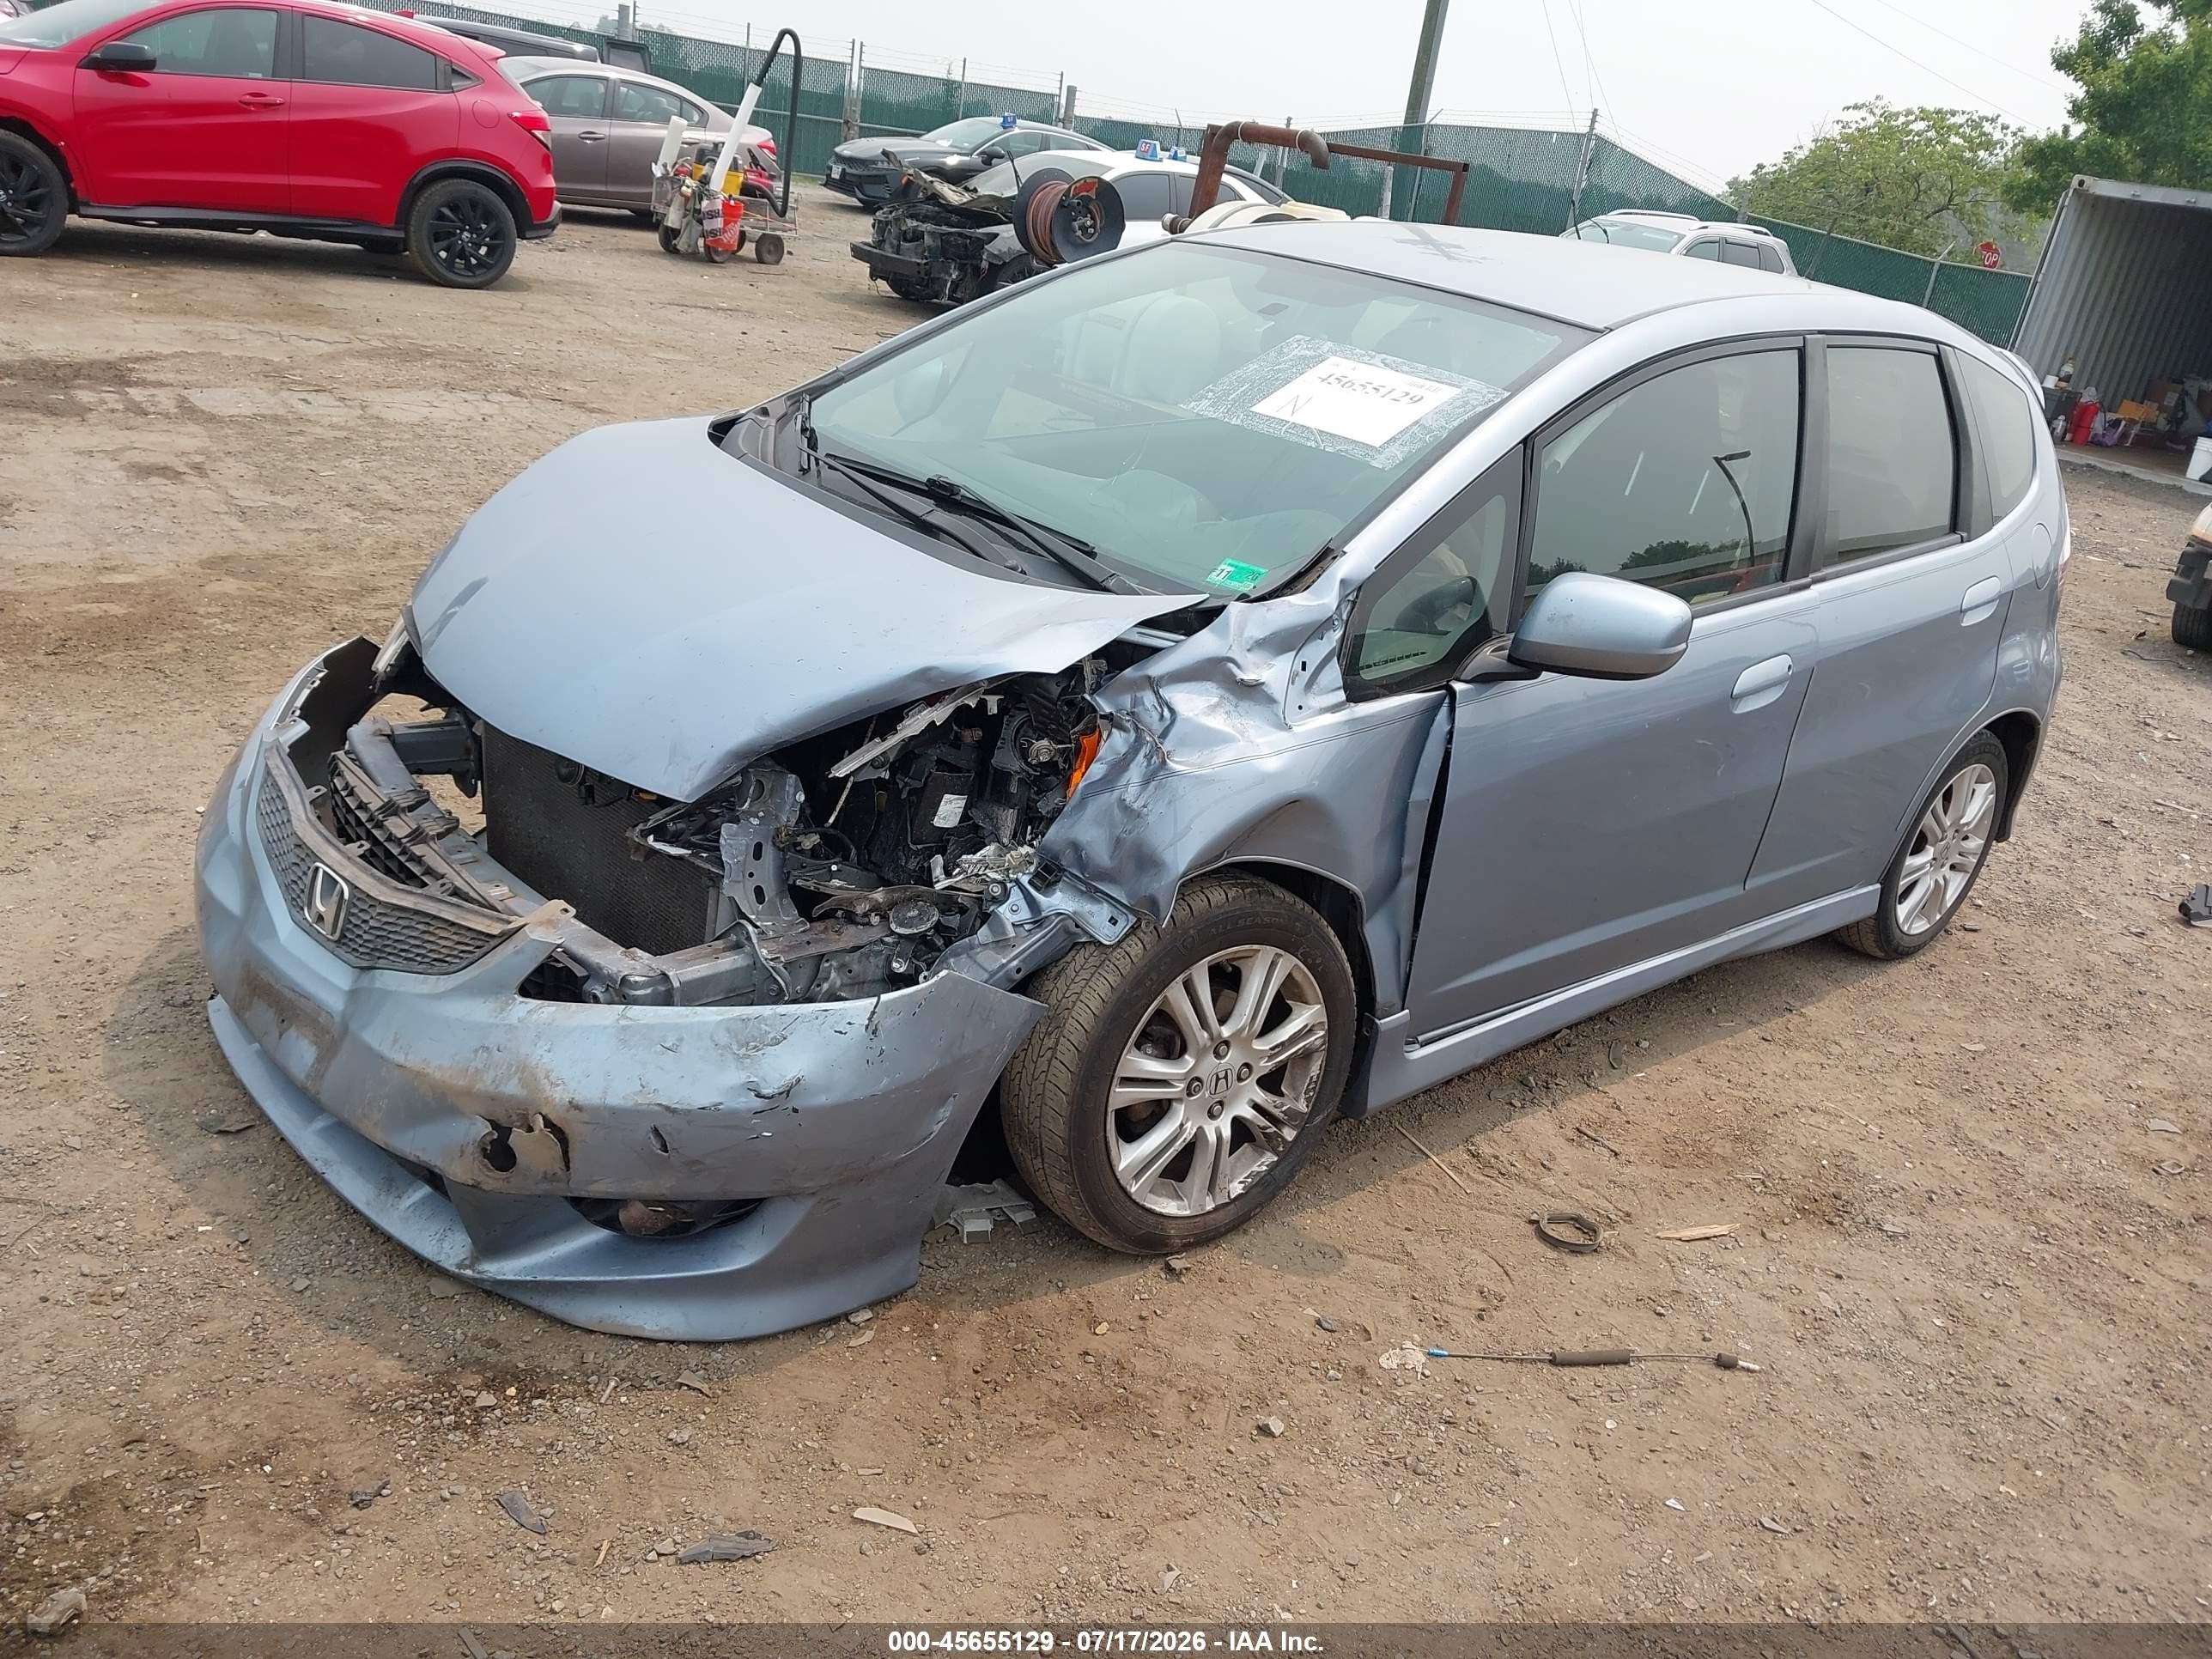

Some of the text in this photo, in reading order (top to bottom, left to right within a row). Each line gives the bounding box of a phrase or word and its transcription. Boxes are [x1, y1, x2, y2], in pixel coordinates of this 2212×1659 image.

[1140, 143, 1151, 153] SF
[1981, 251, 1999, 265] TOP
[1317, 373, 1425, 404] 45655129
